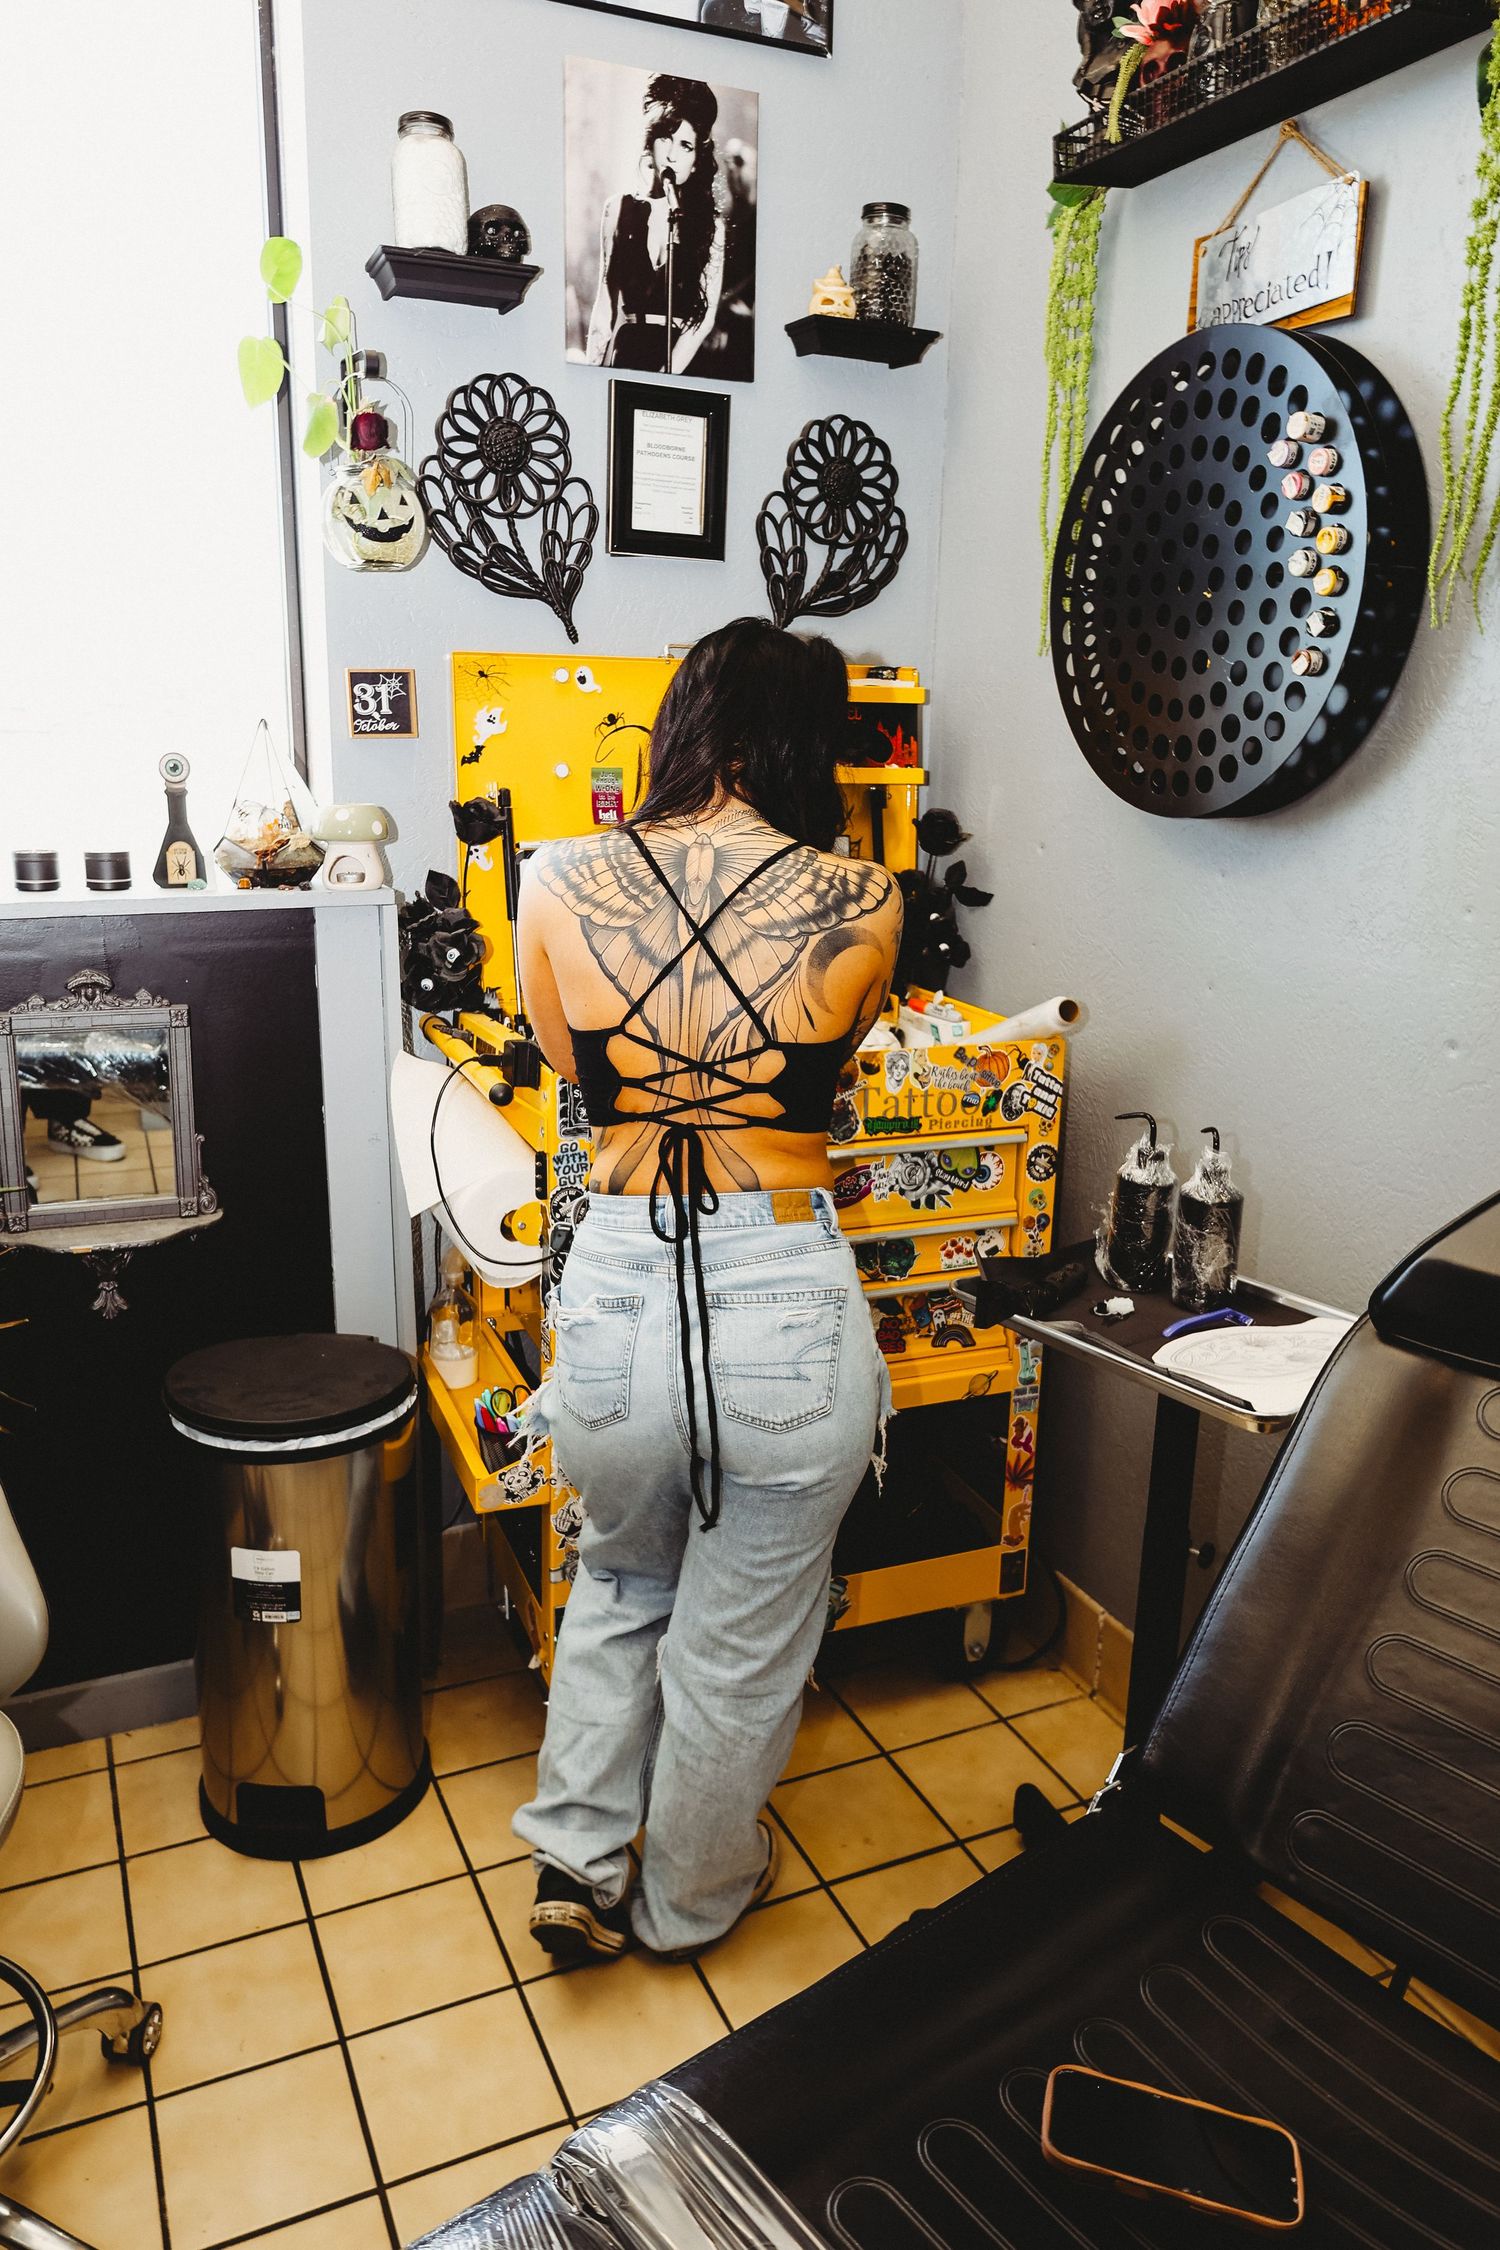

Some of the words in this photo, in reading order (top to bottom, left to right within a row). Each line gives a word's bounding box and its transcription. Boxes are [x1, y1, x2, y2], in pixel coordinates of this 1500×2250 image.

[1211, 251, 1332, 325] appreciated!
[646, 442, 686, 452] BLOODBORNE
[636, 449, 671, 459] PATHOGENS
[672, 454, 696, 462] COURSE
[353, 682, 393, 716] 31
[353, 717, 401, 733] October
[928, 1114, 993, 1130] Piercing
[560, 1142, 578, 1154] GO
[553, 1151, 588, 1165] WITH
[554, 1162, 588, 1176] YOUR
[559, 1174, 584, 1187] GUT
